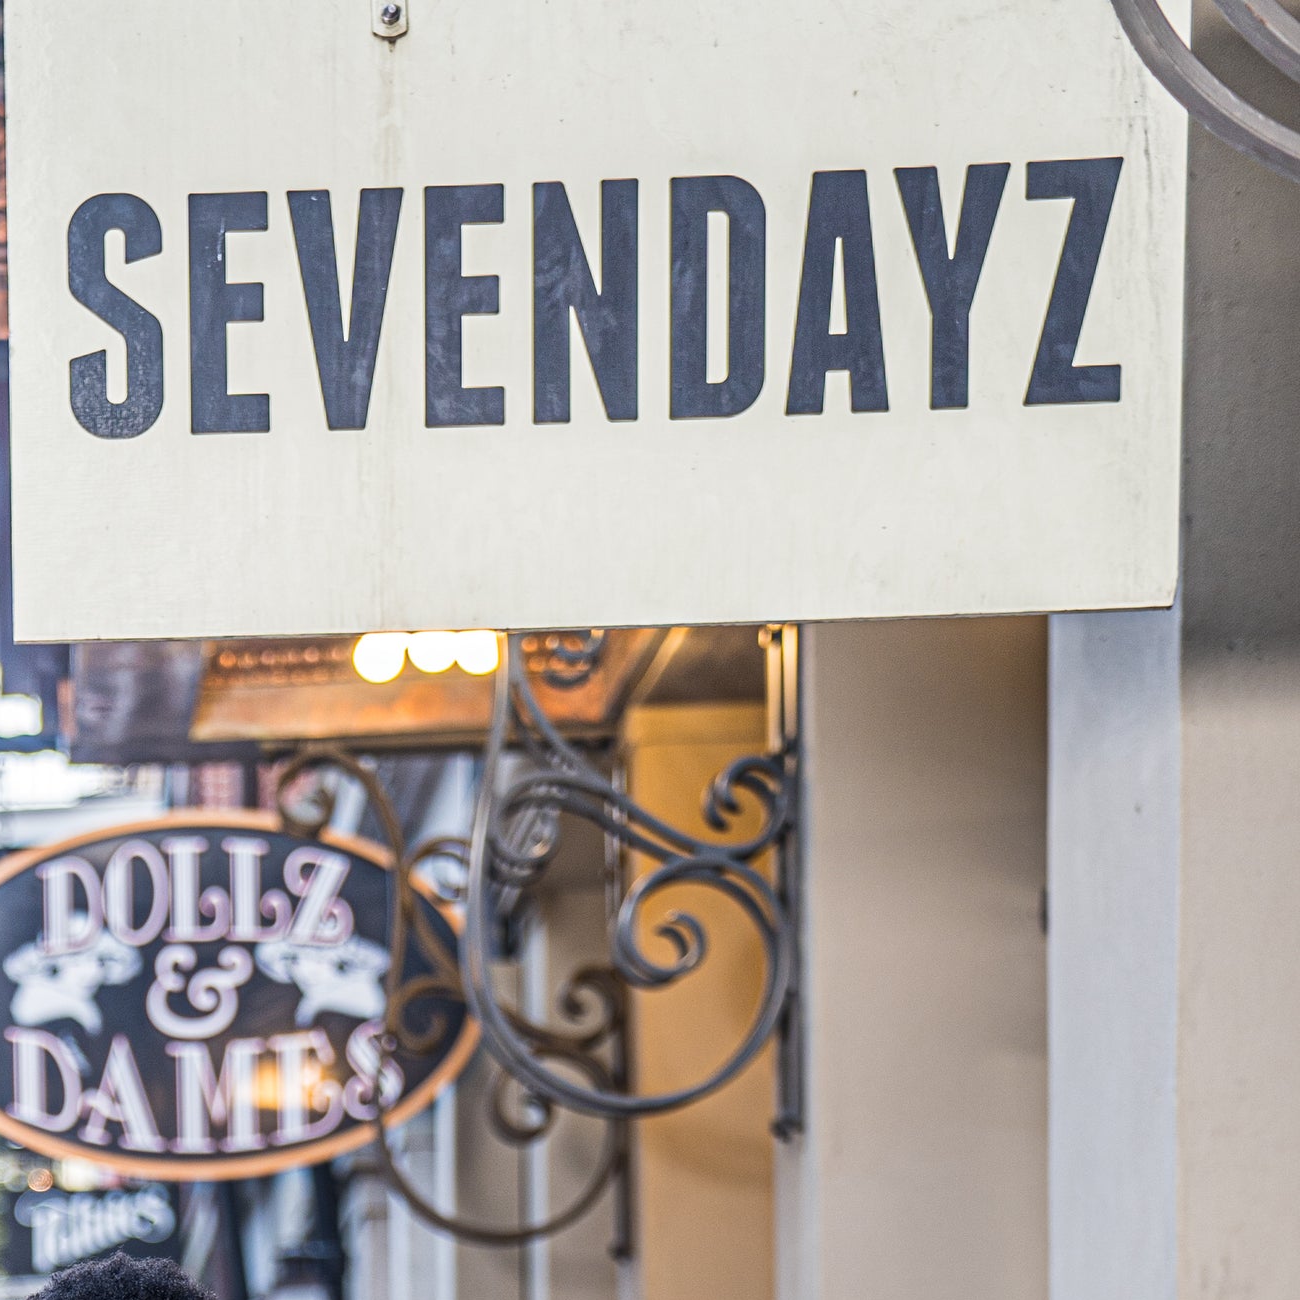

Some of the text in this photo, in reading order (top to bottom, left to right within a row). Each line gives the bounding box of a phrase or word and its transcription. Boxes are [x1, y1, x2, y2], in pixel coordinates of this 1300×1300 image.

[66, 157, 1124, 440] SEVENDAYZ
[36, 836, 355, 956] DOLLZ
[146, 944, 253, 1040] &
[4, 1018, 404, 1154] DAMES
